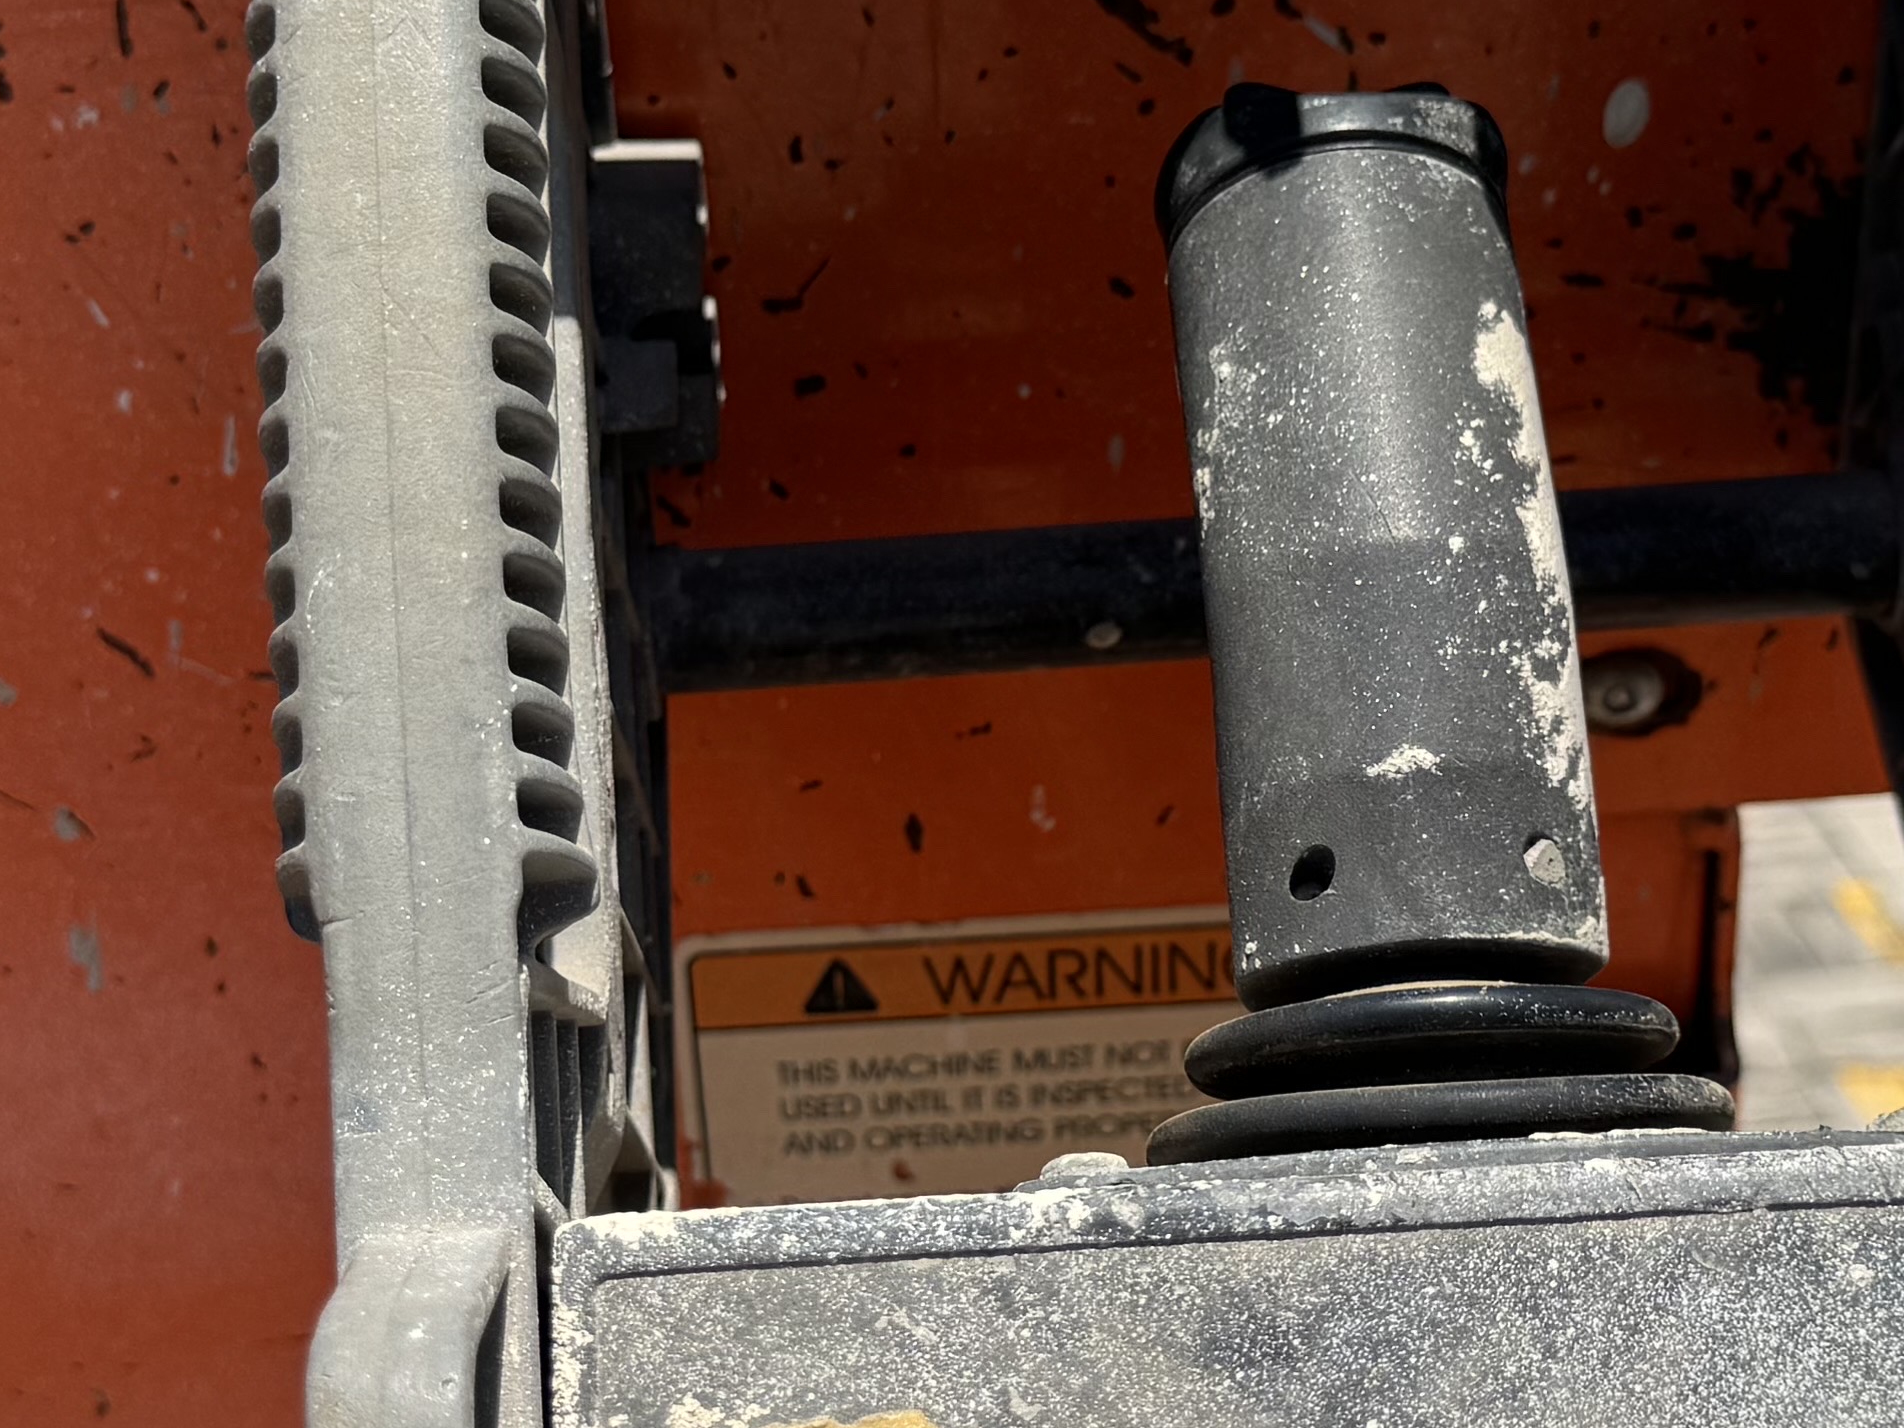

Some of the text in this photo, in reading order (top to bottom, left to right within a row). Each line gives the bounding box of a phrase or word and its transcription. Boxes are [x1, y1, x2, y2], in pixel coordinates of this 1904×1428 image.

[922, 938, 1234, 1006] WARNIN
[777, 1056, 840, 1086] THIS
[846, 1048, 1003, 1083] MACHINE
[1013, 1042, 1093, 1072] MUST
[1104, 1039, 1170, 1068] NOT
[781, 1092, 862, 1121] USED
[870, 1086, 953, 1117] UNTIL
[963, 1083, 984, 1112] IT
[995, 1082, 1018, 1110] IS
[784, 1125, 854, 1156] AND
[864, 1117, 1044, 1152] OPERATING
